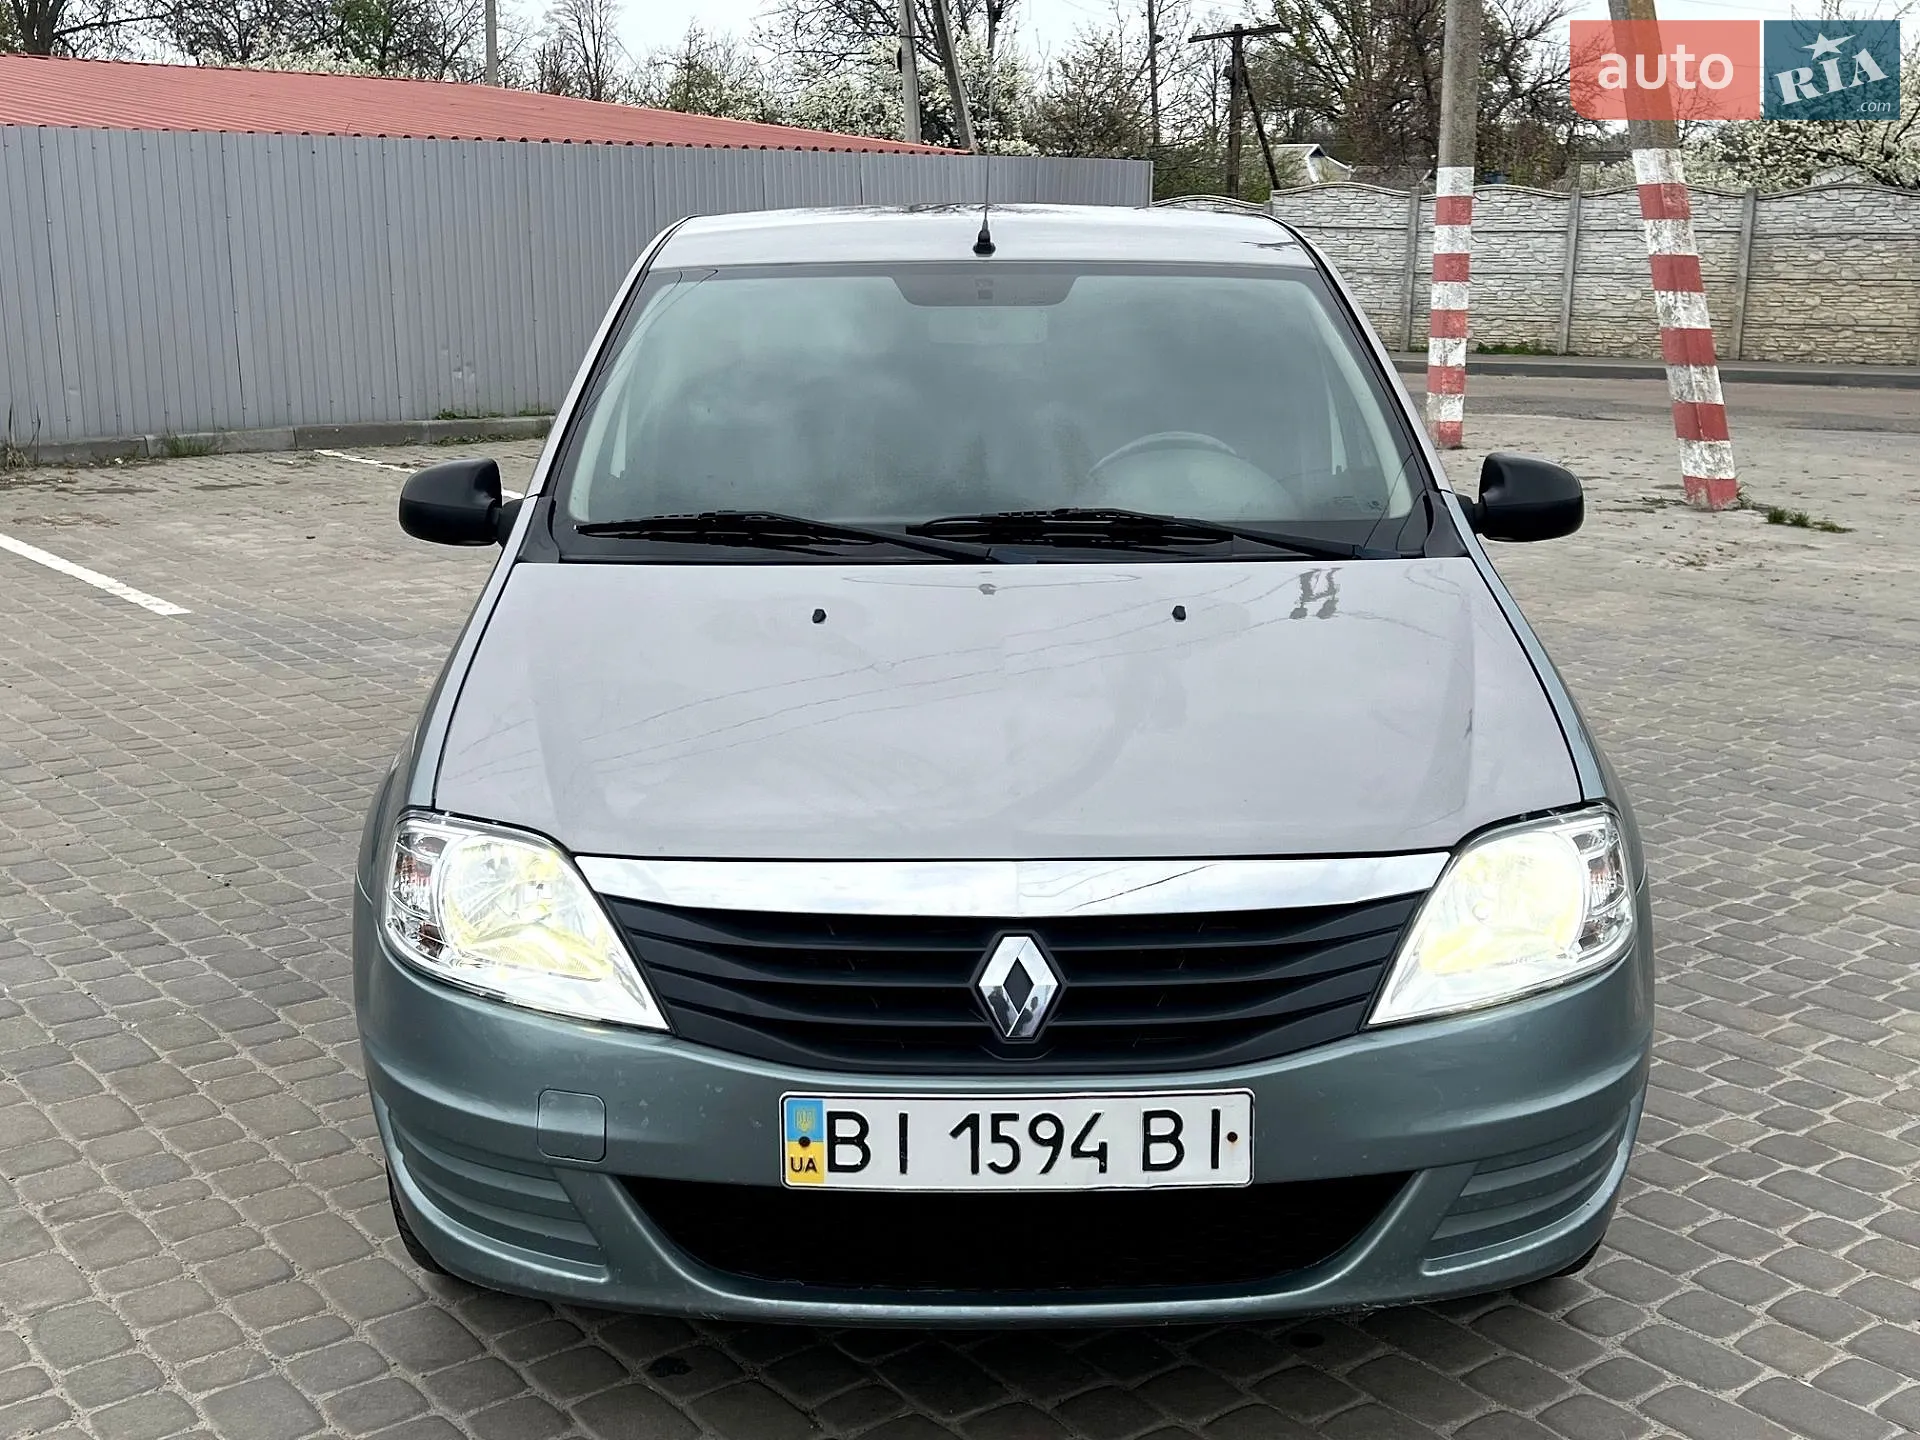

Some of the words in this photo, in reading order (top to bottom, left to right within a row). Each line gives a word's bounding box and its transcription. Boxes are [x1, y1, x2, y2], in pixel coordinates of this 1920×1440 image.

[826, 1110, 909, 1174] BI
[949, 1112, 1108, 1175] 1594
[1141, 1108, 1222, 1171] BI
[790, 1156, 818, 1173] UA
